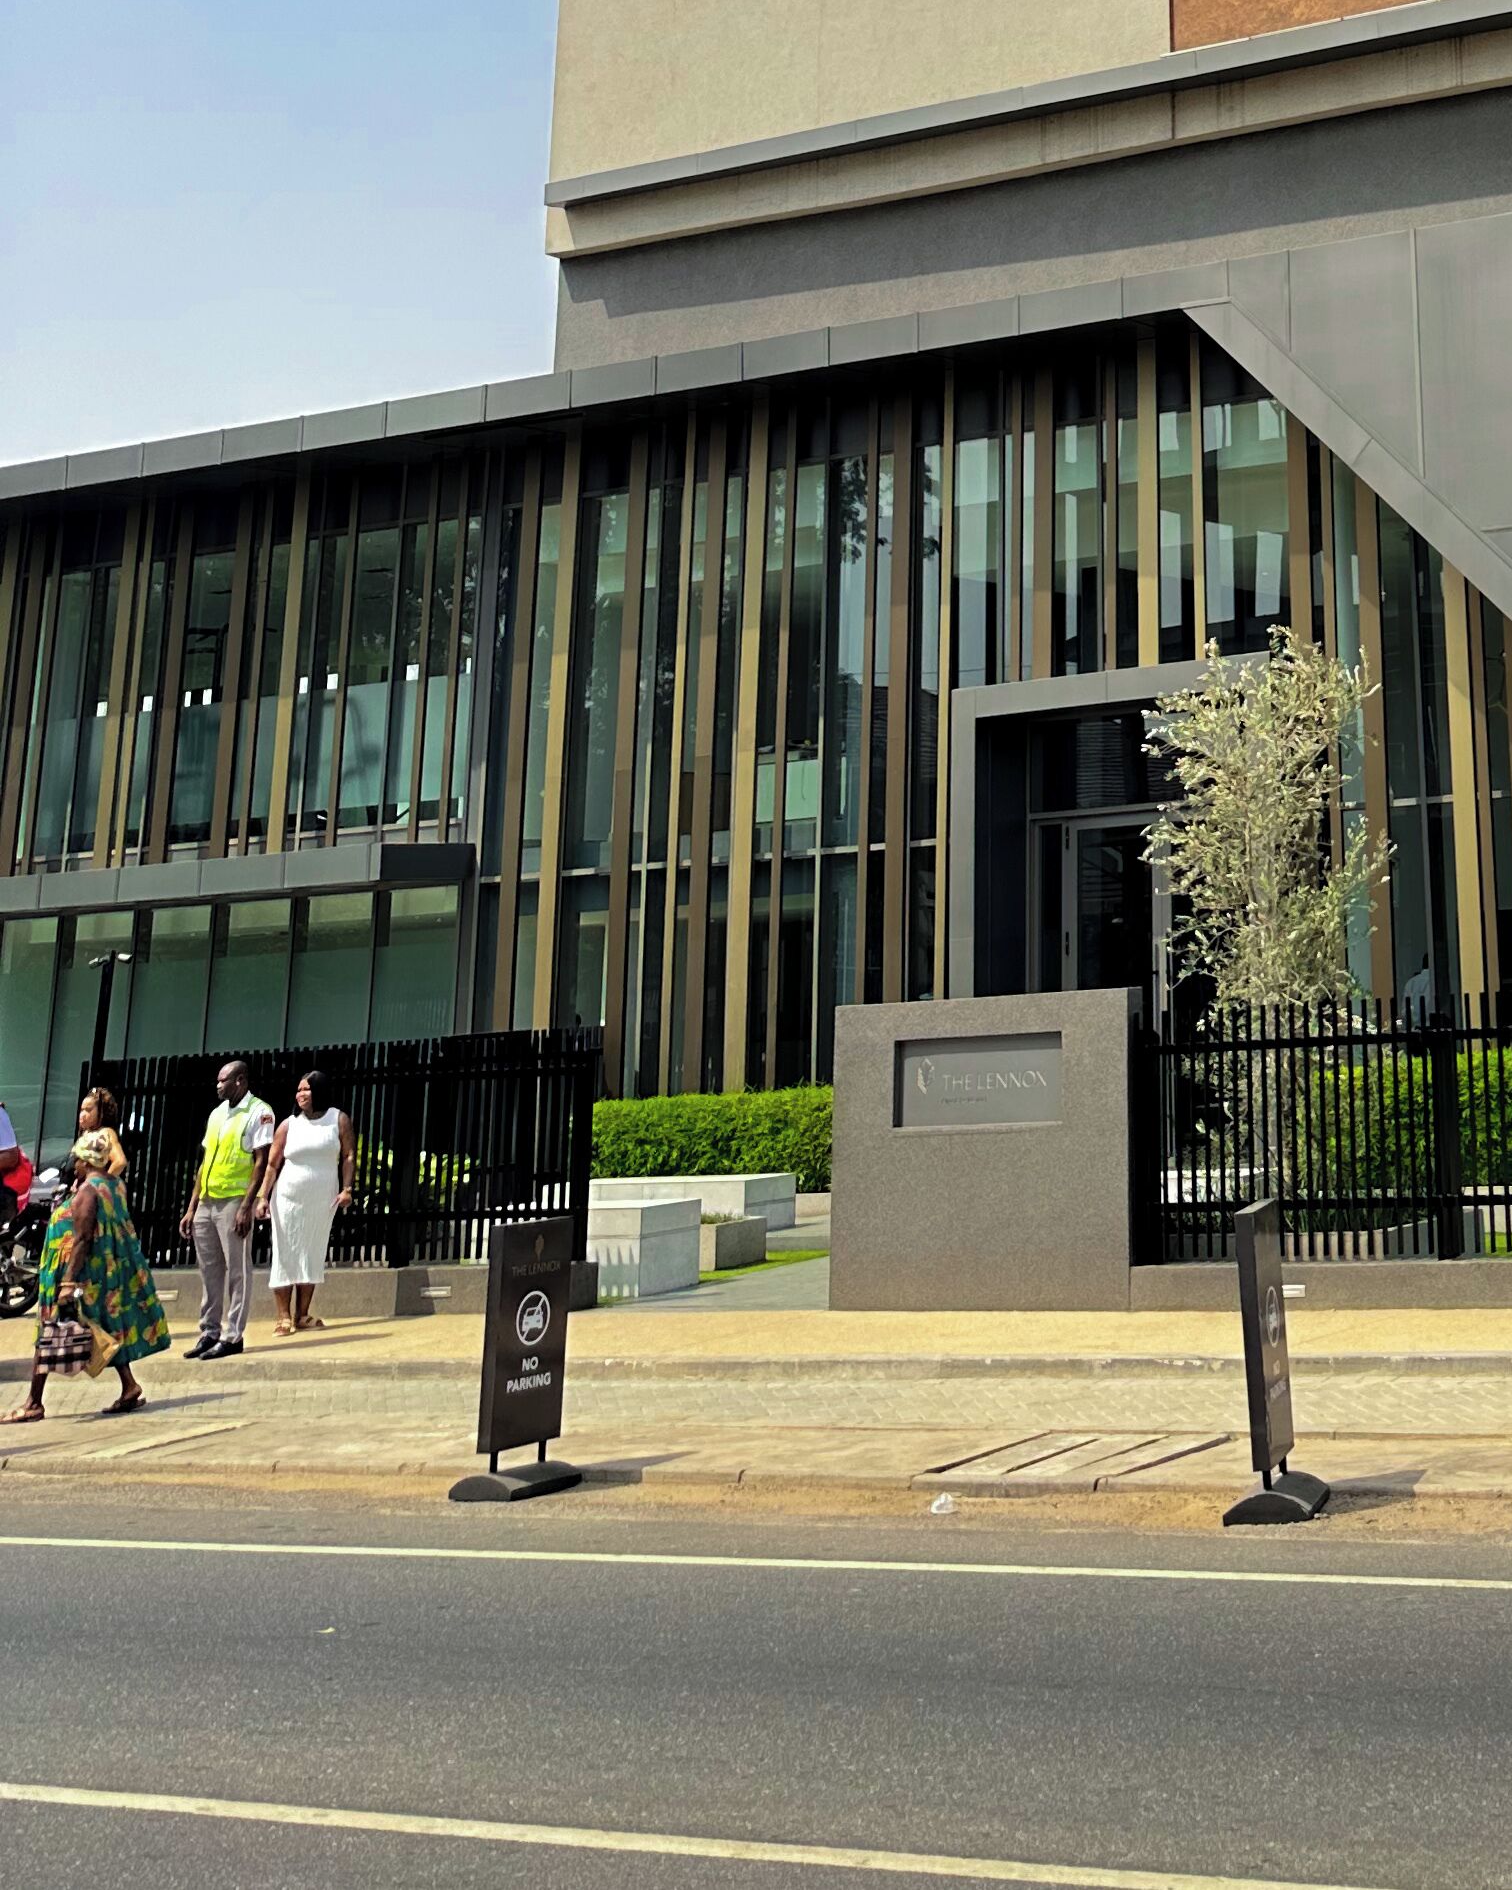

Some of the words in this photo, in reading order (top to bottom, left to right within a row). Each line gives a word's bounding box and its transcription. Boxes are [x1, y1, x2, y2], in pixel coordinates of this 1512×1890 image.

[943, 1074, 972, 1091] THE
[977, 1070, 1047, 1090] LENNOX
[511, 1264, 527, 1277] THE
[522, 1356, 539, 1372] NO
[506, 1372, 551, 1394] PARKING
